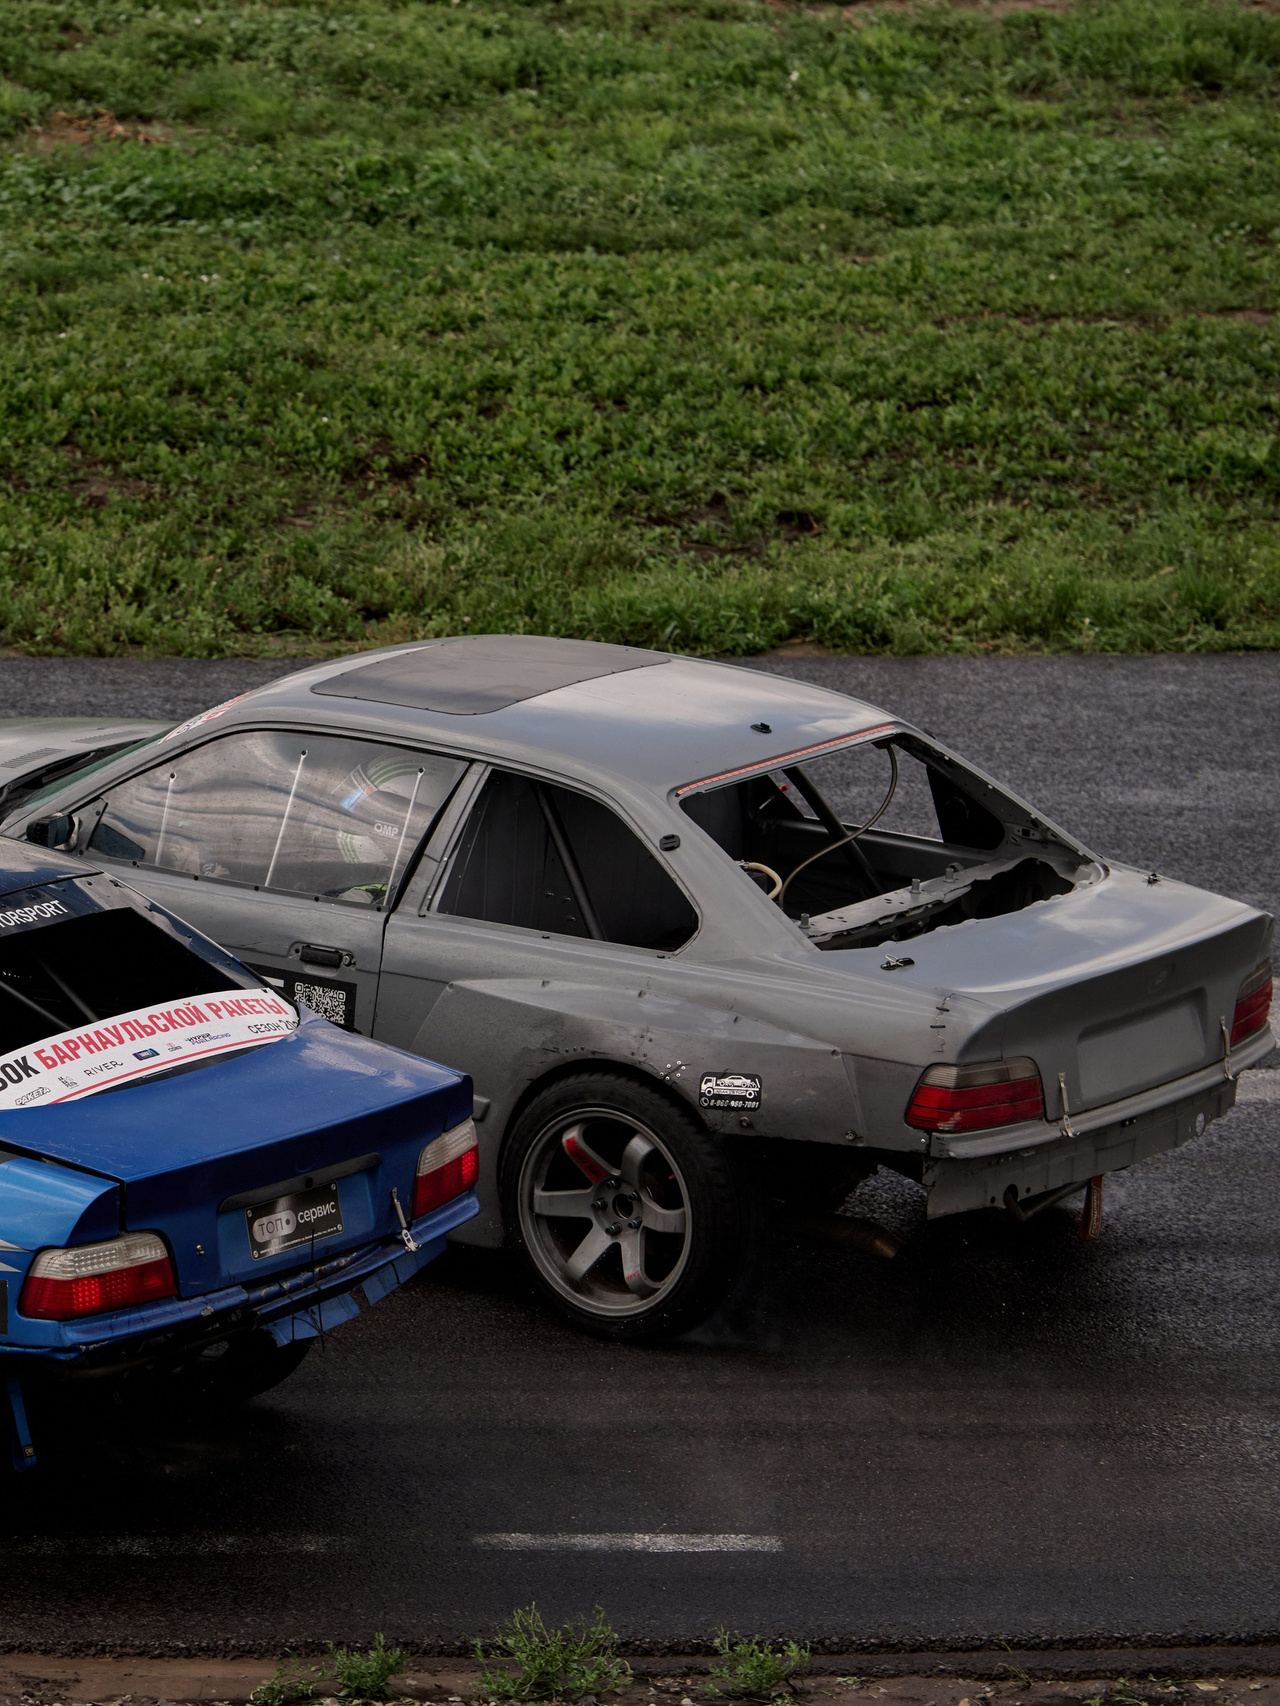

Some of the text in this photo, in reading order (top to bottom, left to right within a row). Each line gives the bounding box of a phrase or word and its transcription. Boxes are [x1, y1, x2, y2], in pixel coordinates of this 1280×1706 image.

[374, 823, 399, 837] OMP
[33, 1002, 210, 1070] БАРНАУЛЬСКОЙ
[204, 998, 289, 1020] РАКЕТЫ
[247, 1022, 285, 1034] СЕЗОН
[83, 1060, 124, 1077] RIVER
[258, 1201, 336, 1236] ТОП сервис
